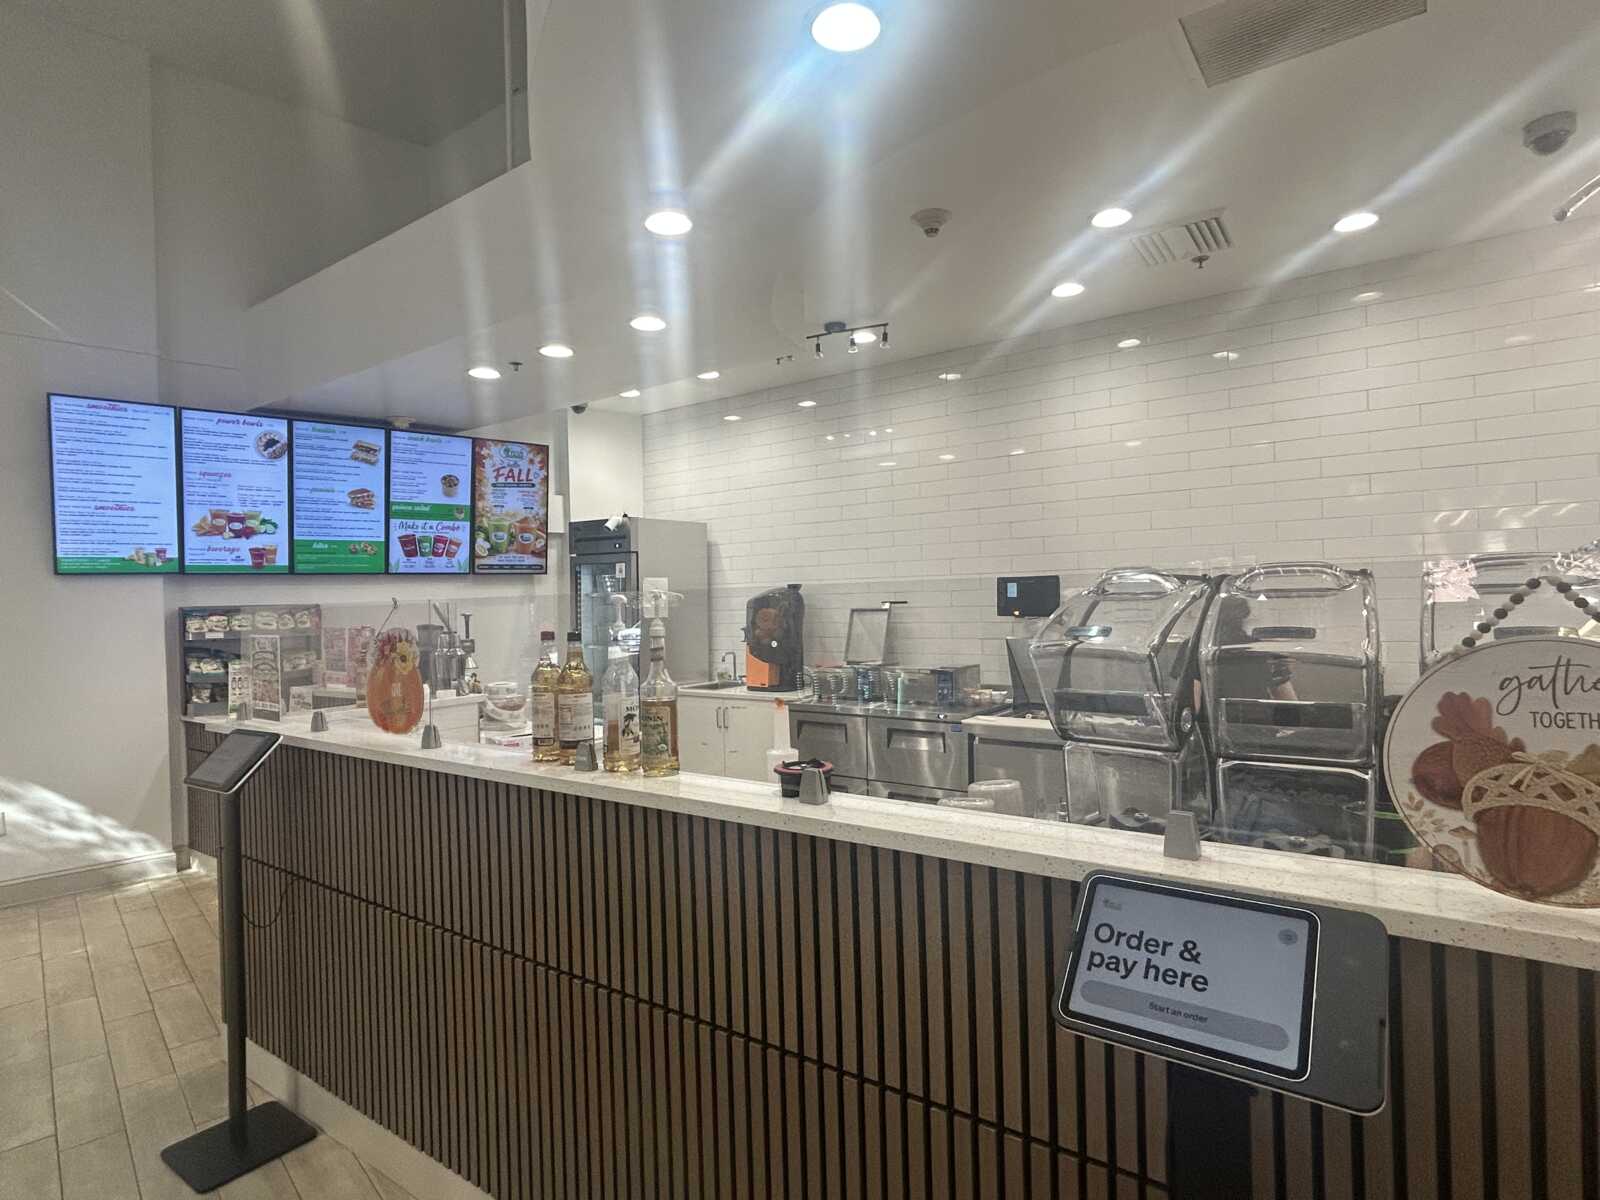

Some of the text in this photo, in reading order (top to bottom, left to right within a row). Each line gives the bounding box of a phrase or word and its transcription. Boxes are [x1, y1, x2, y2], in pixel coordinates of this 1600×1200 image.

[492, 465, 534, 482] FALL
[399, 520, 419, 530] Make
[436, 521, 460, 531] Combo
[1094, 922, 1202, 965] Order &
[1086, 950, 1209, 993] pay here
[1148, 1000, 1208, 1023] Start an order
